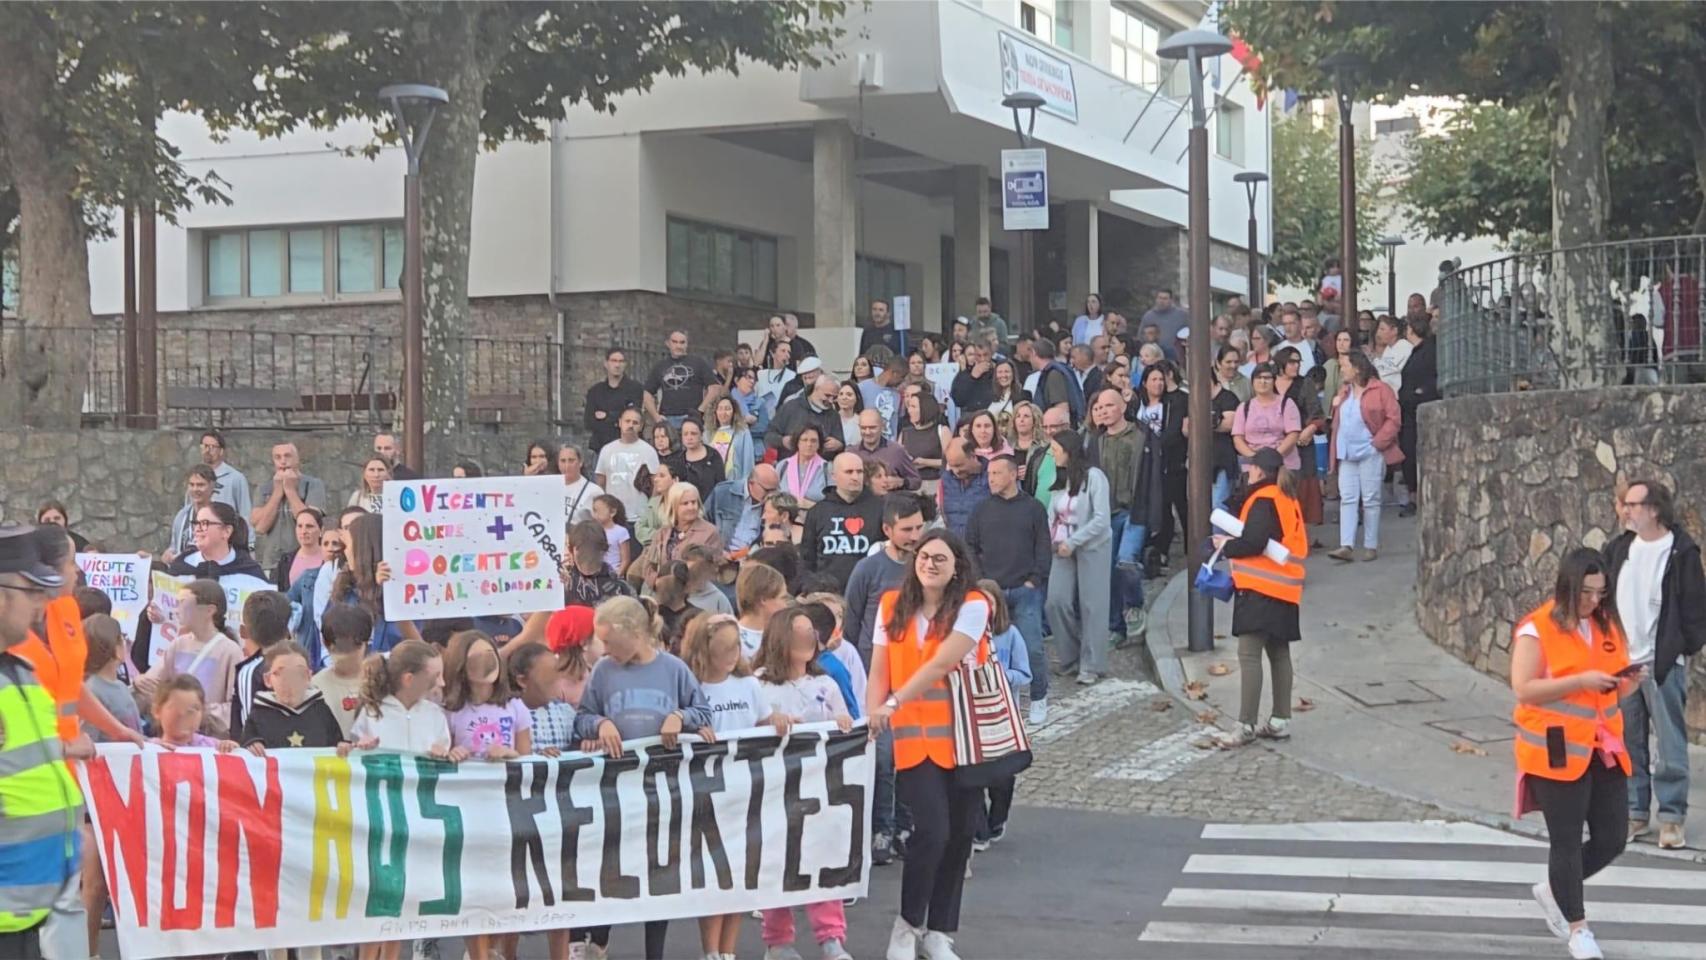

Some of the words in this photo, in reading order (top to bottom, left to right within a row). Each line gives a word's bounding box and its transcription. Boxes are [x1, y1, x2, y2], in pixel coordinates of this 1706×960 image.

[400, 486, 416, 513] O
[421, 484, 516, 513] VICENTE
[830, 517, 845, 535] I
[822, 535, 870, 554] DAD
[83, 557, 135, 573] VICENTE
[404, 548, 539, 577] DOCENTES
[85, 752, 283, 931] NON
[308, 754, 464, 922] AOS
[505, 726, 871, 910] RECORTES
